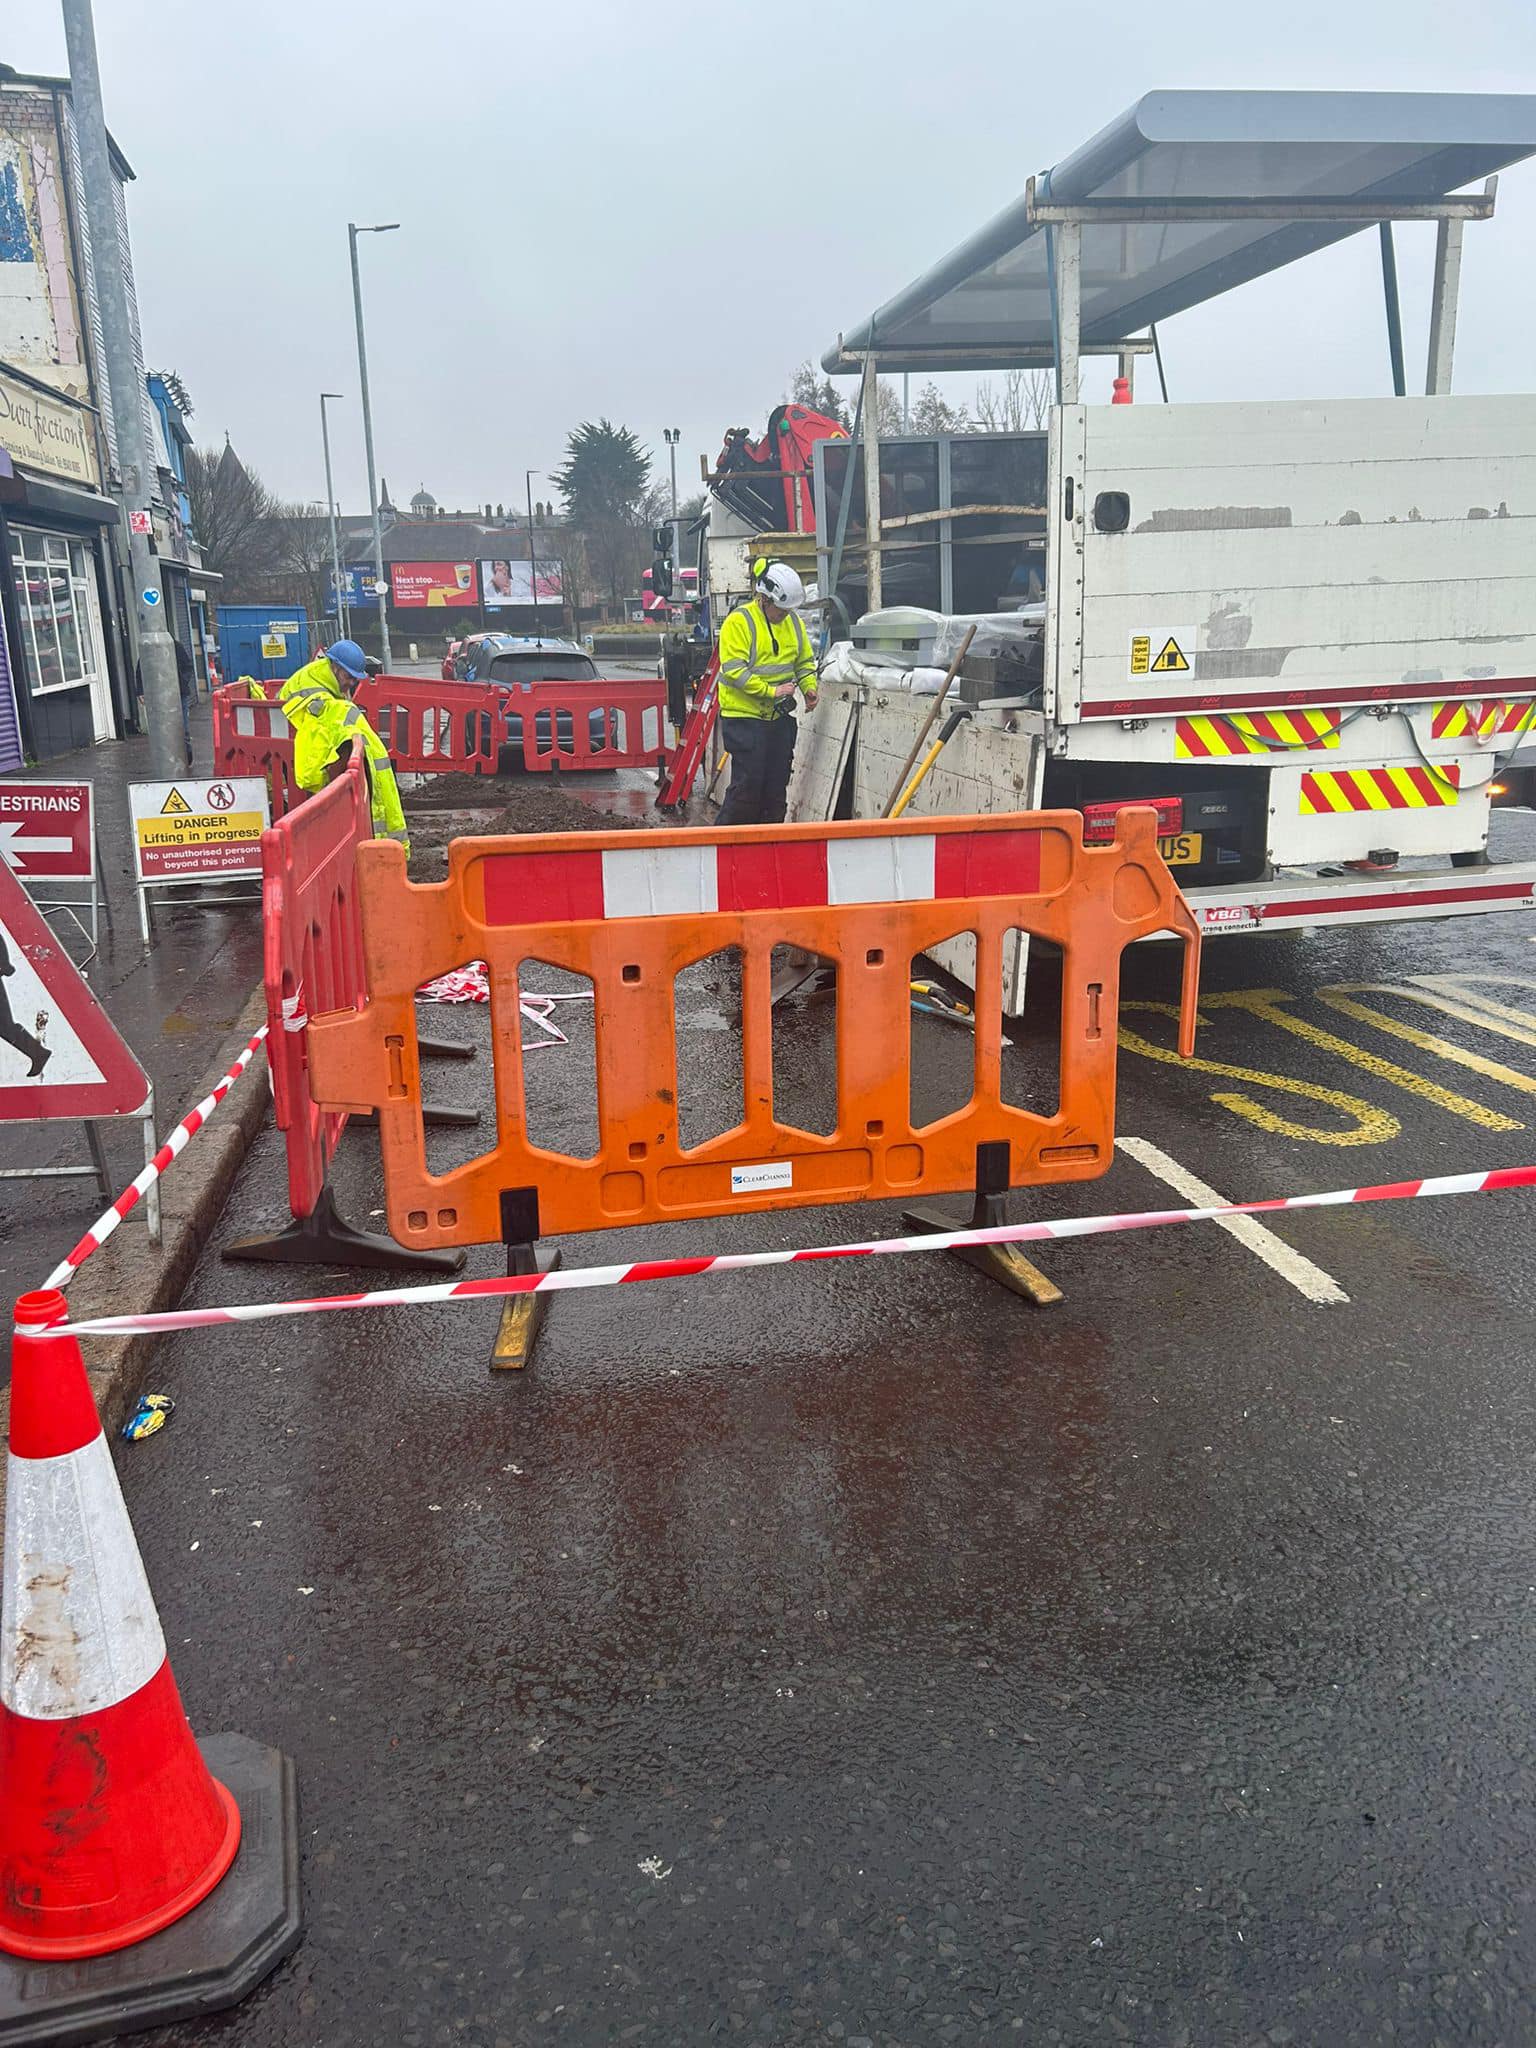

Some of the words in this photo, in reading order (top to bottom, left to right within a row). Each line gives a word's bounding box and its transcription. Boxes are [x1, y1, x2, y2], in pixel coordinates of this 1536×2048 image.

[396, 576, 414, 584] Next
[0, 796, 81, 812] ESTRIANS
[174, 816, 228, 829] DANGER
[144, 833, 184, 844] Lifting
[189, 831, 200, 840] in
[205, 828, 260, 841] progress
[145, 852, 159, 860] No
[162, 847, 222, 859] unauthorised
[225, 845, 262, 856] persons
[1156, 837, 1191, 861] US
[164, 860, 199, 869] beyond
[202, 858, 218, 866] this
[222, 856, 245, 865] point
[1208, 908, 1241, 920] VBG
